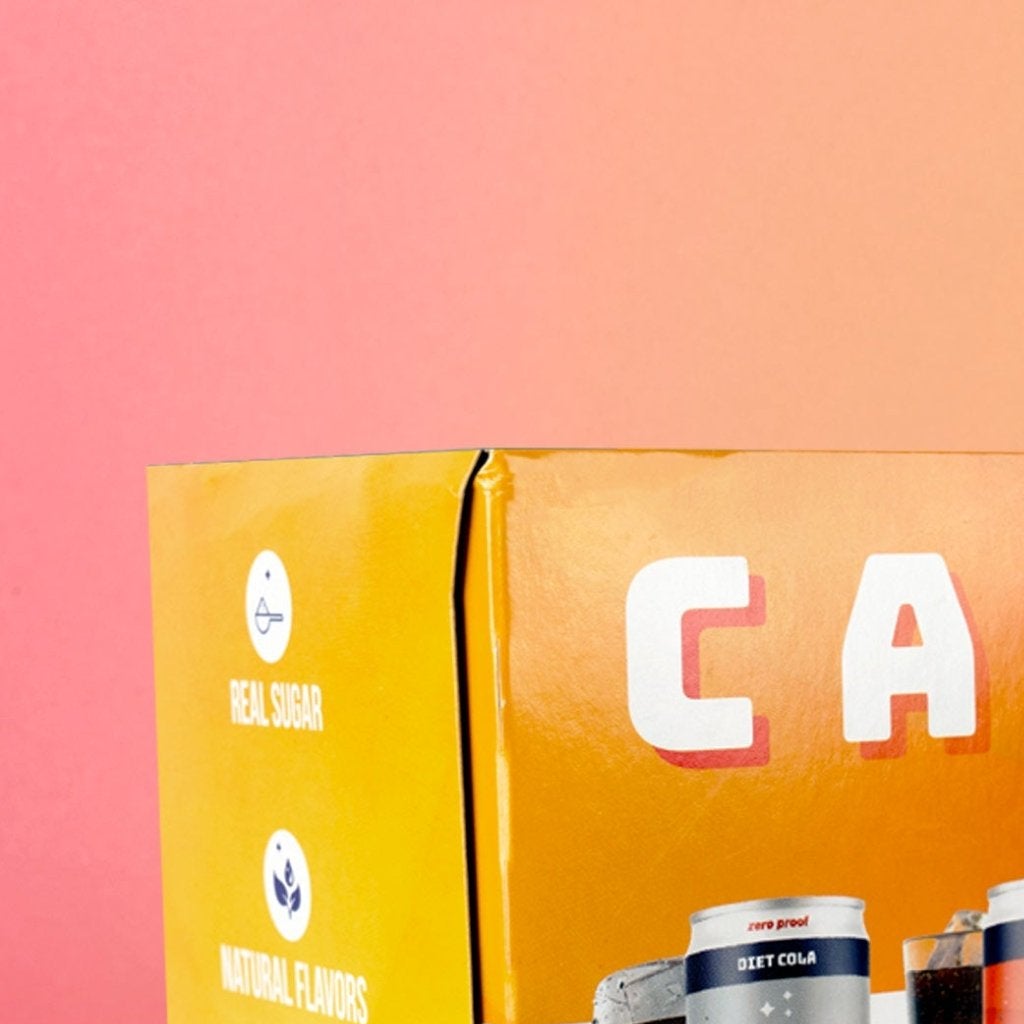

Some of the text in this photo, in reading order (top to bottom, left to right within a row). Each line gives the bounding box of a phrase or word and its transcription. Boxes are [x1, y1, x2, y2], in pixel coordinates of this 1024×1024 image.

[229, 679, 323, 732] REAL SUGAR
[748, 915, 809, 931] zero proof
[219, 943, 294, 1007] NATURAL
[737, 950, 817, 972] DIET COLA
